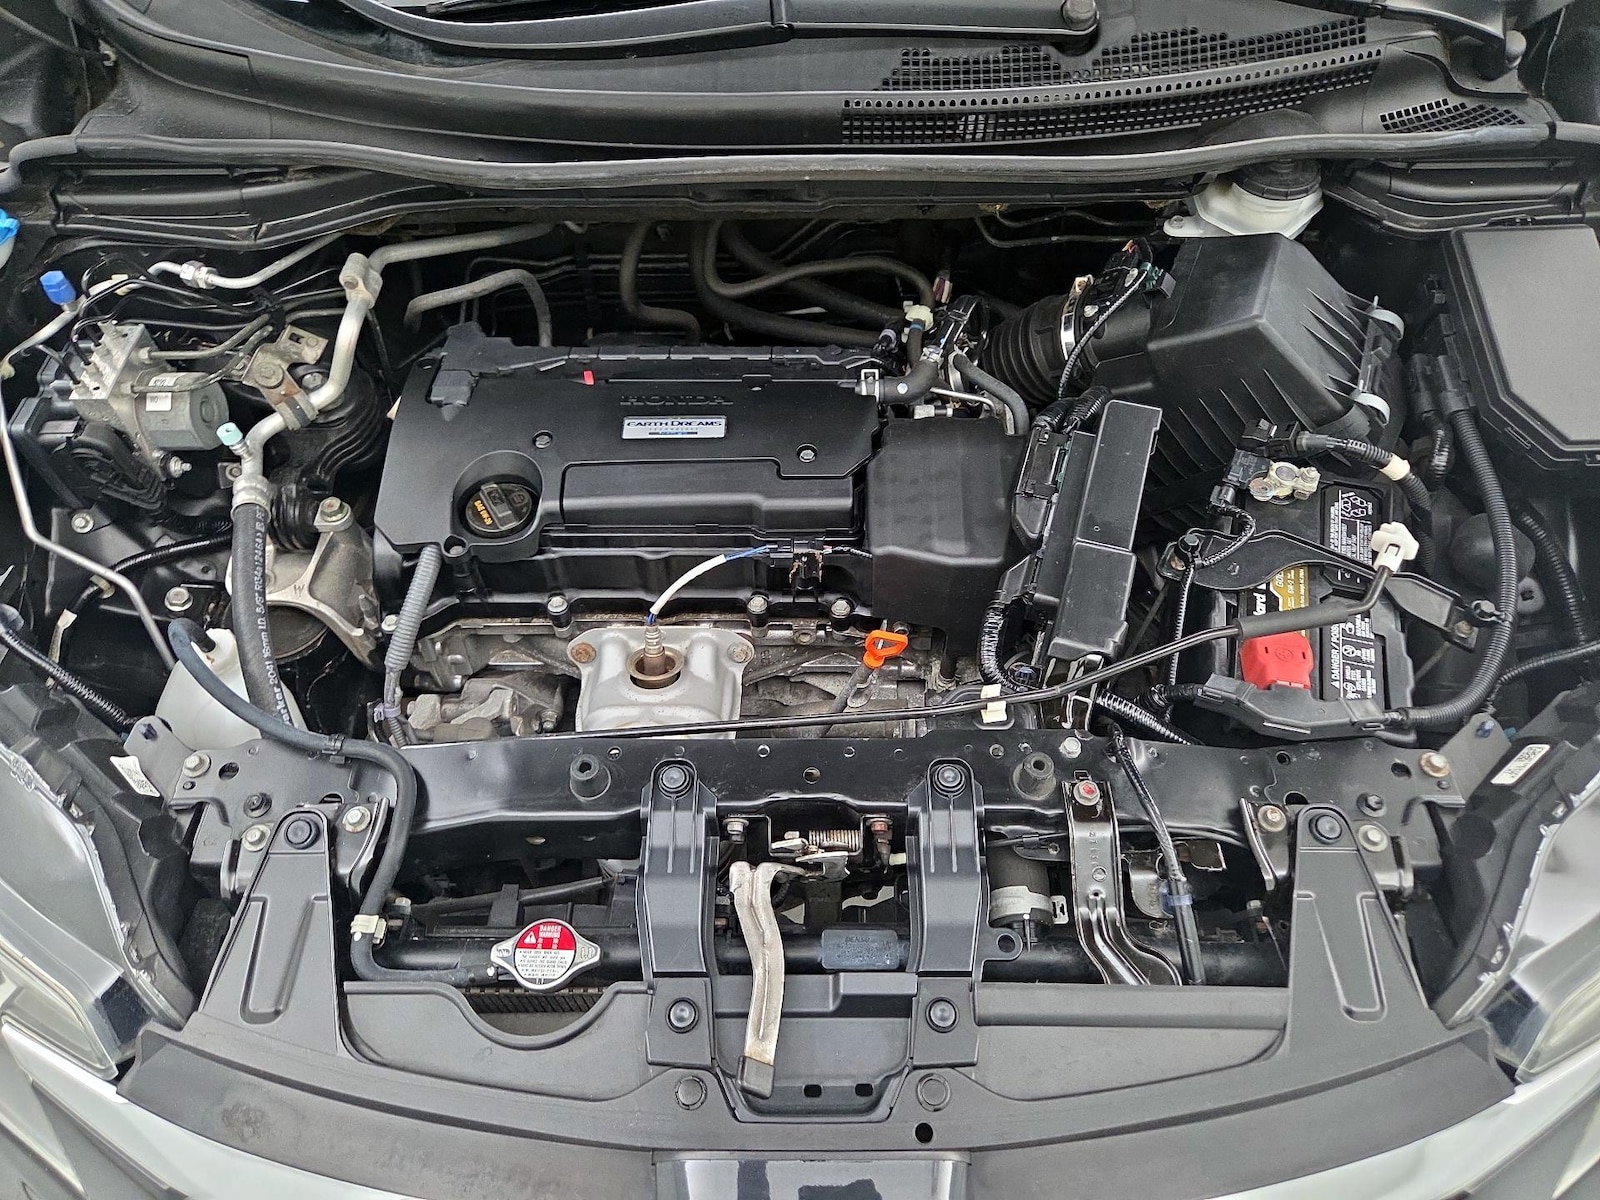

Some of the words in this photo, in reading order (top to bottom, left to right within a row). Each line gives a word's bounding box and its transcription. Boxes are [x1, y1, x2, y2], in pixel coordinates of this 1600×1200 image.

[620, 395, 734, 406] HONDA
[261, 631, 272, 658] 16mm
[265, 660, 278, 685] 2041
